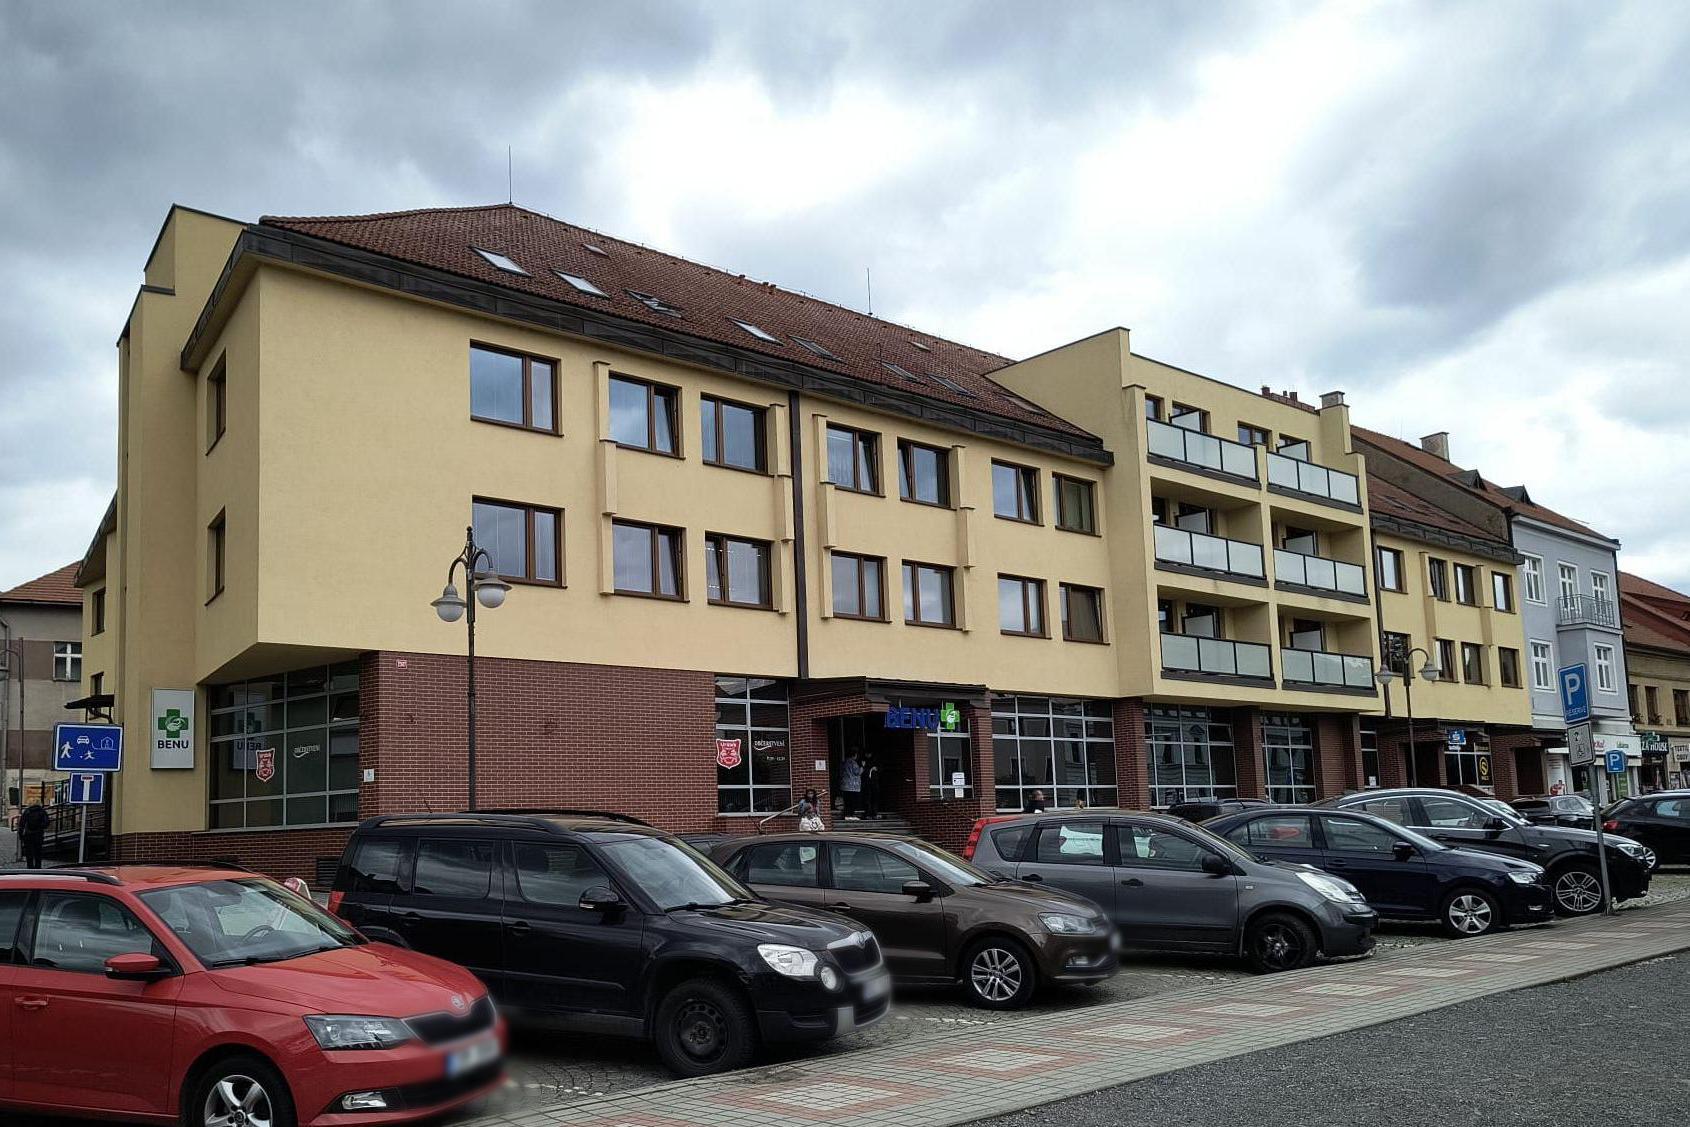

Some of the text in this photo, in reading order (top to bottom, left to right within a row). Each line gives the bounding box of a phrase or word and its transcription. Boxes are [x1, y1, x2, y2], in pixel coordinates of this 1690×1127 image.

[1565, 673, 1580, 705] P
[885, 707, 939, 729] BENU
[158, 740, 189, 749] BENU
[1610, 754, 1619, 766] P
